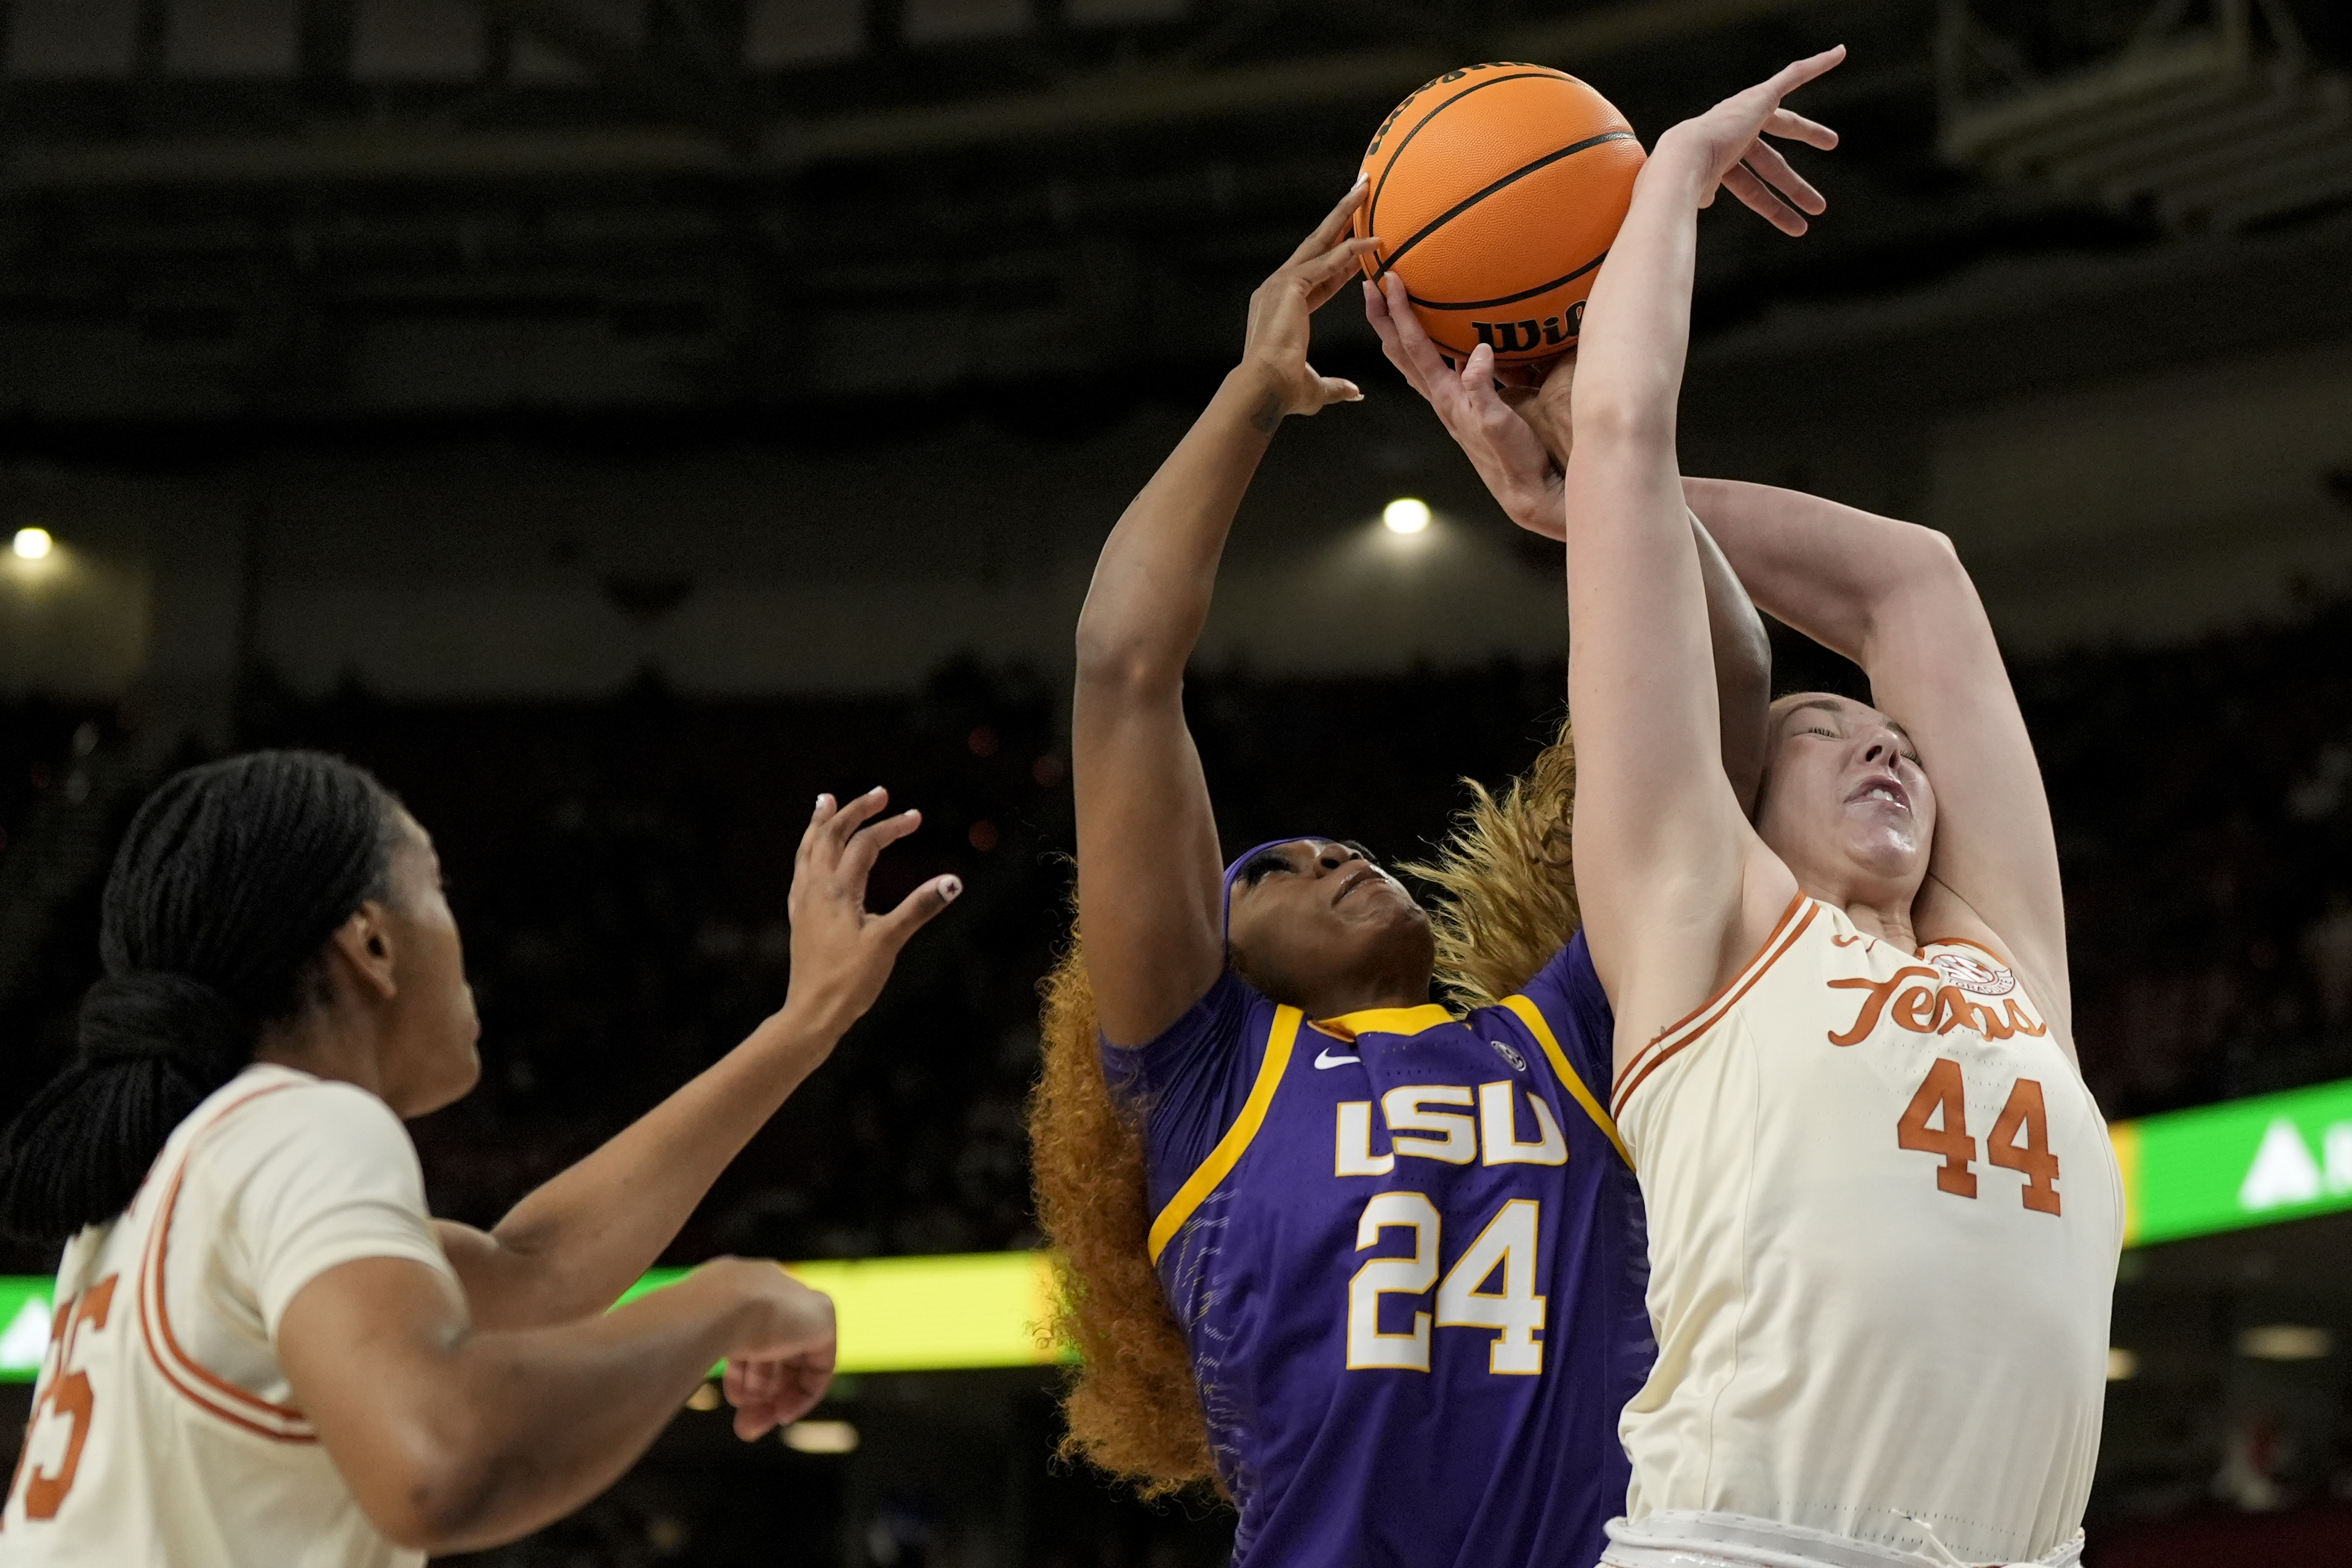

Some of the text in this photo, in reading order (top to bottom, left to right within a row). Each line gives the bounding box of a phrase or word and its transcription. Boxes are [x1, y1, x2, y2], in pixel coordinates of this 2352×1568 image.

[1827, 966, 2047, 1046] Texas
[1335, 1080, 1569, 1177] LSU
[1897, 1058, 2061, 1217] 44
[1346, 1191, 1546, 1374] 24
[6, 1271, 119, 1525] 5
